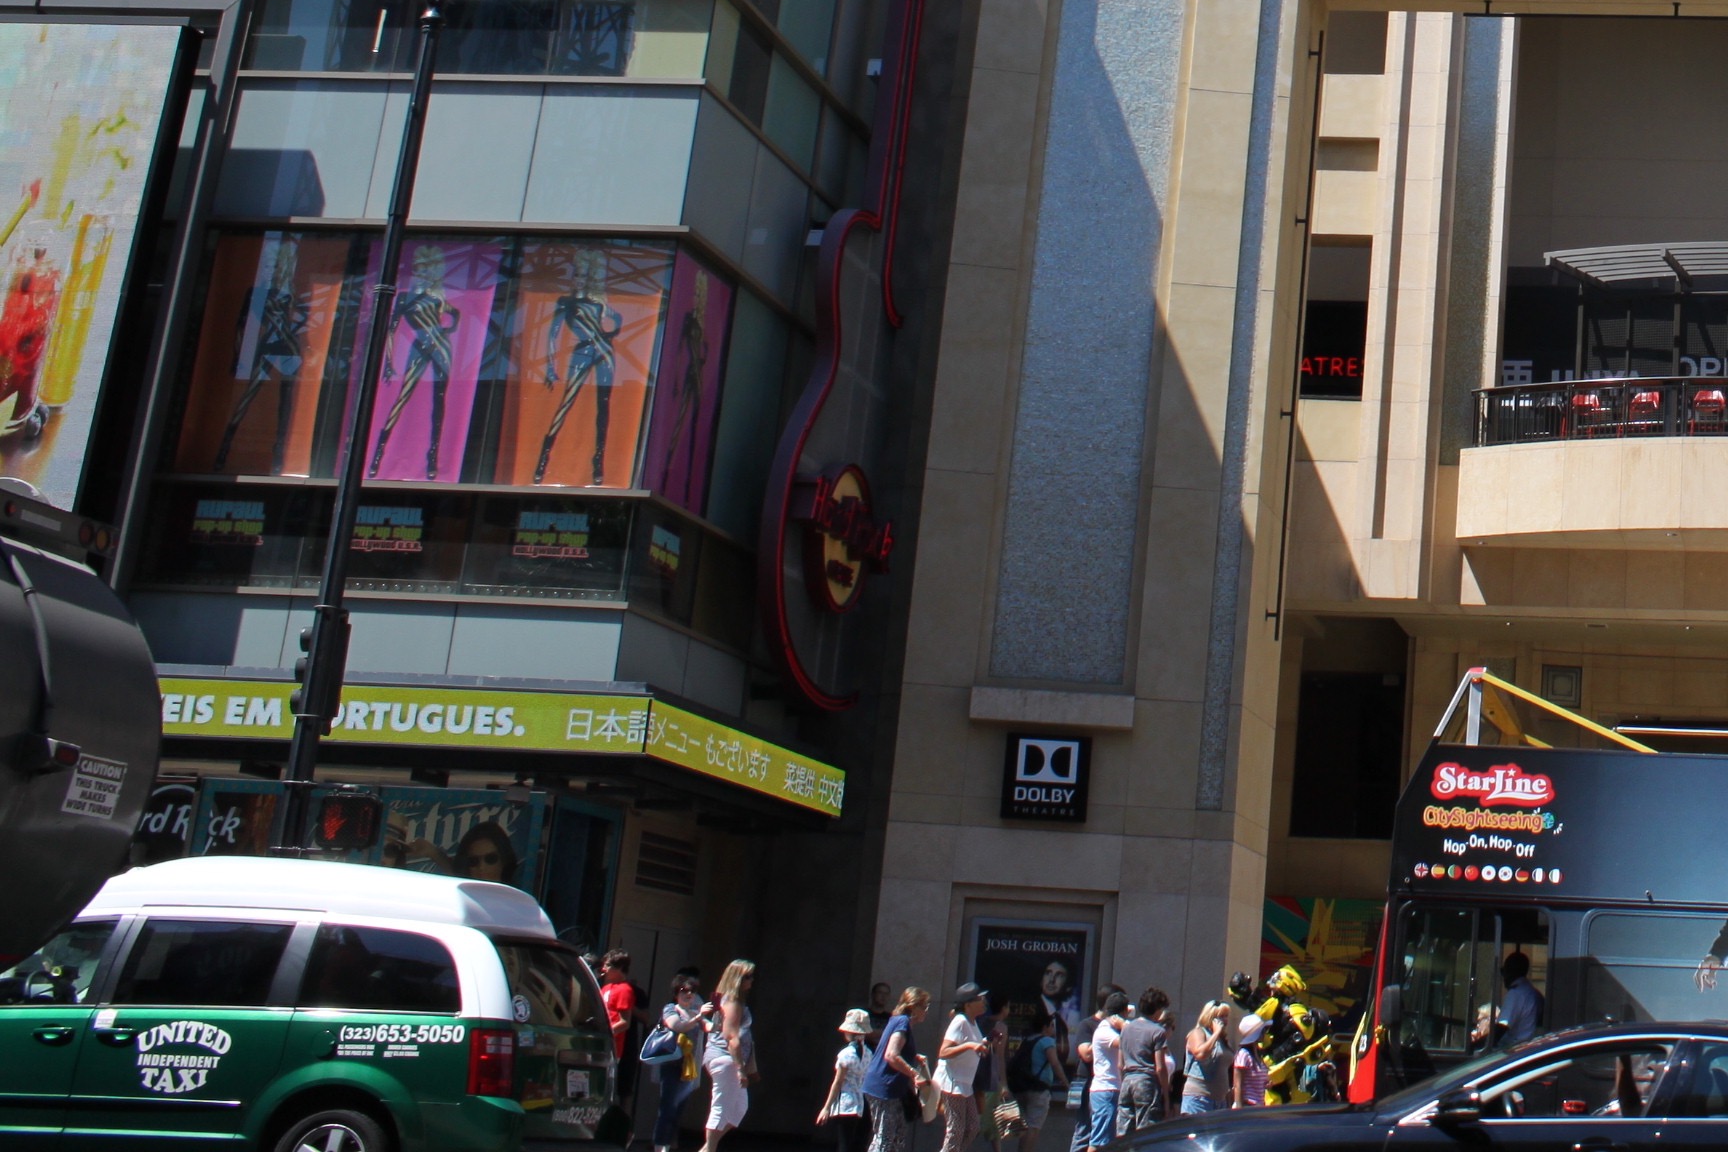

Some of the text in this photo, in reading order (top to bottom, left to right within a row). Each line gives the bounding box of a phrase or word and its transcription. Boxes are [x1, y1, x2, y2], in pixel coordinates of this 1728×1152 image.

[1300, 356, 1364, 376] ATRE
[224, 696, 281, 726] EM
[294, 699, 525, 737] ORTUGUES.
[81, 759, 122, 779] CAUTION
[1014, 786, 1075, 803] DOLBY
[1437, 767, 1549, 800] StarLine
[1013, 805, 1075, 816] THEATRE
[1423, 805, 1544, 834] CitySightseeing
[138, 803, 241, 844] rd Rck
[986, 938, 1078, 953] JOSH GROBAN
[138, 1021, 232, 1054] UNITED
[138, 1054, 221, 1068] INDEPENDENT
[141, 1068, 208, 1093] TAXI
